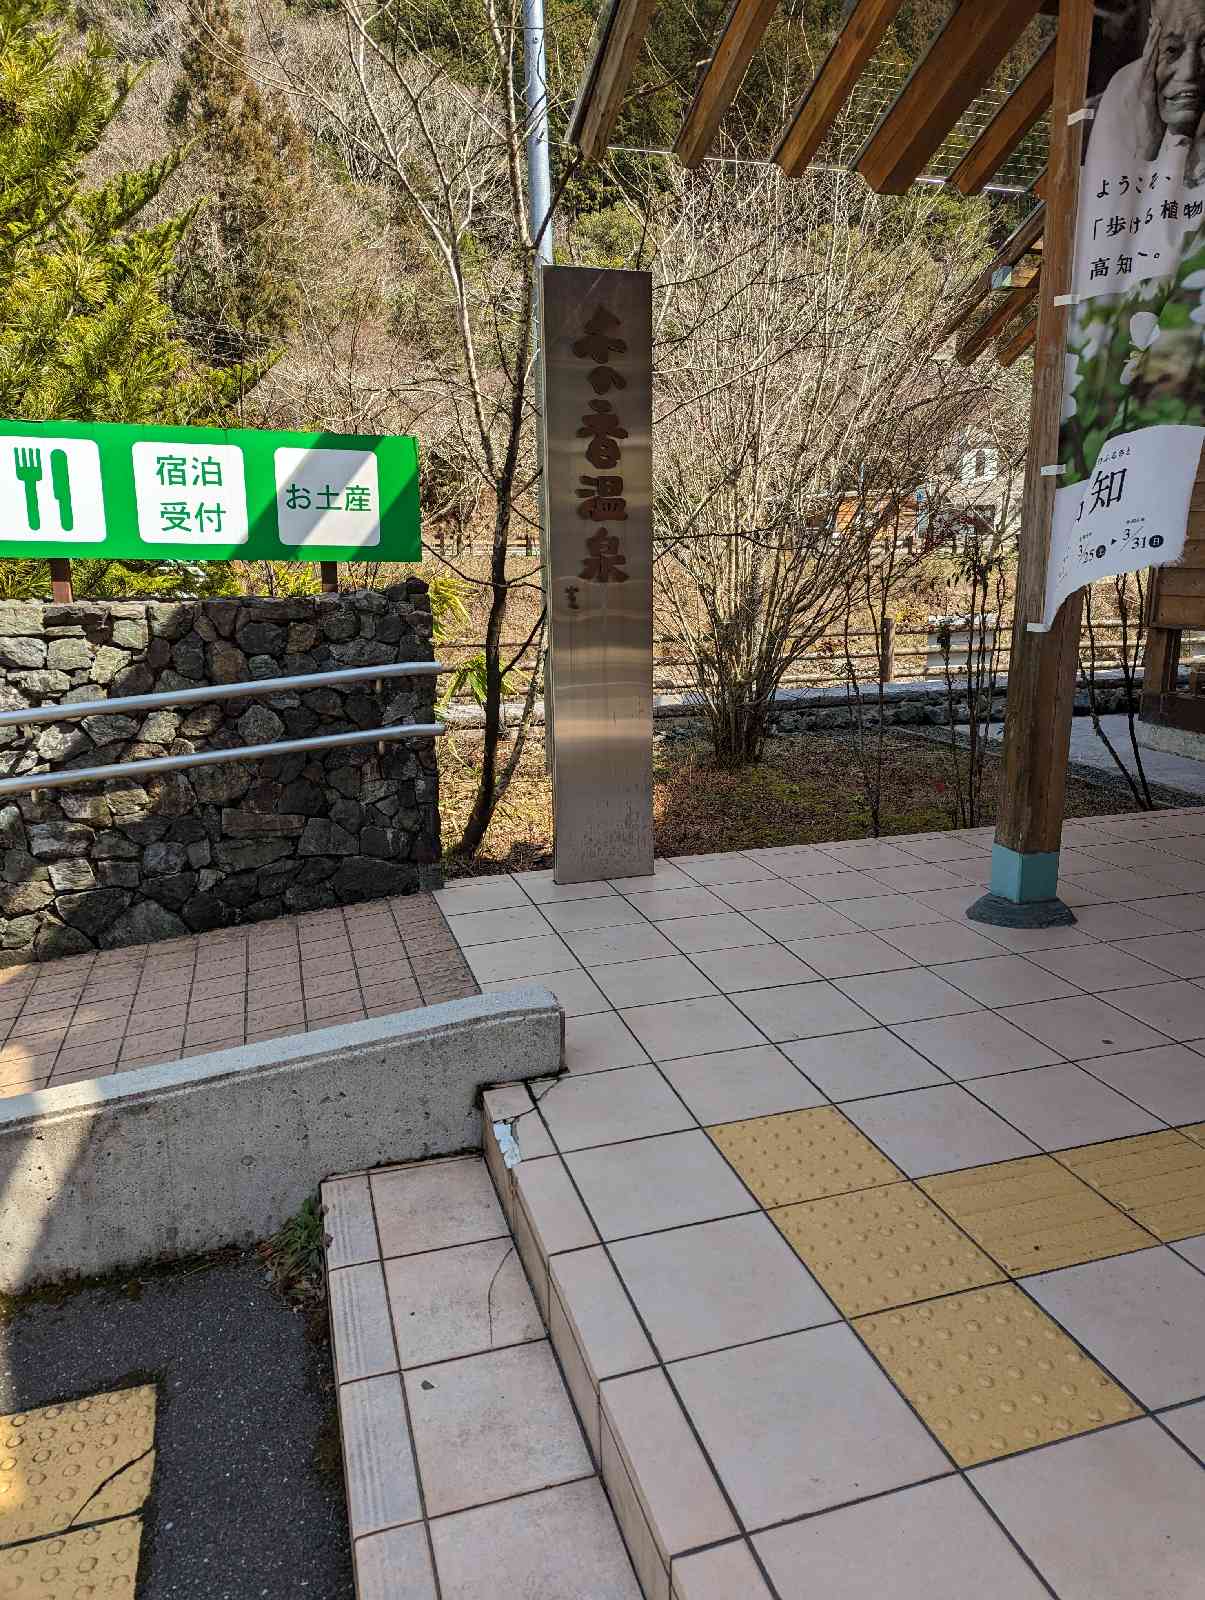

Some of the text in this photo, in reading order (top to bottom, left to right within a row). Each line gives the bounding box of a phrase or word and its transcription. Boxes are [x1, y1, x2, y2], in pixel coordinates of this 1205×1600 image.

[1090, 252, 1160, 280] 高知へ。
[155, 455, 223, 488] 宿泊
[285, 483, 372, 513] お土産
[1075, 468, 1127, 523] 知
[159, 501, 226, 533] 受付
